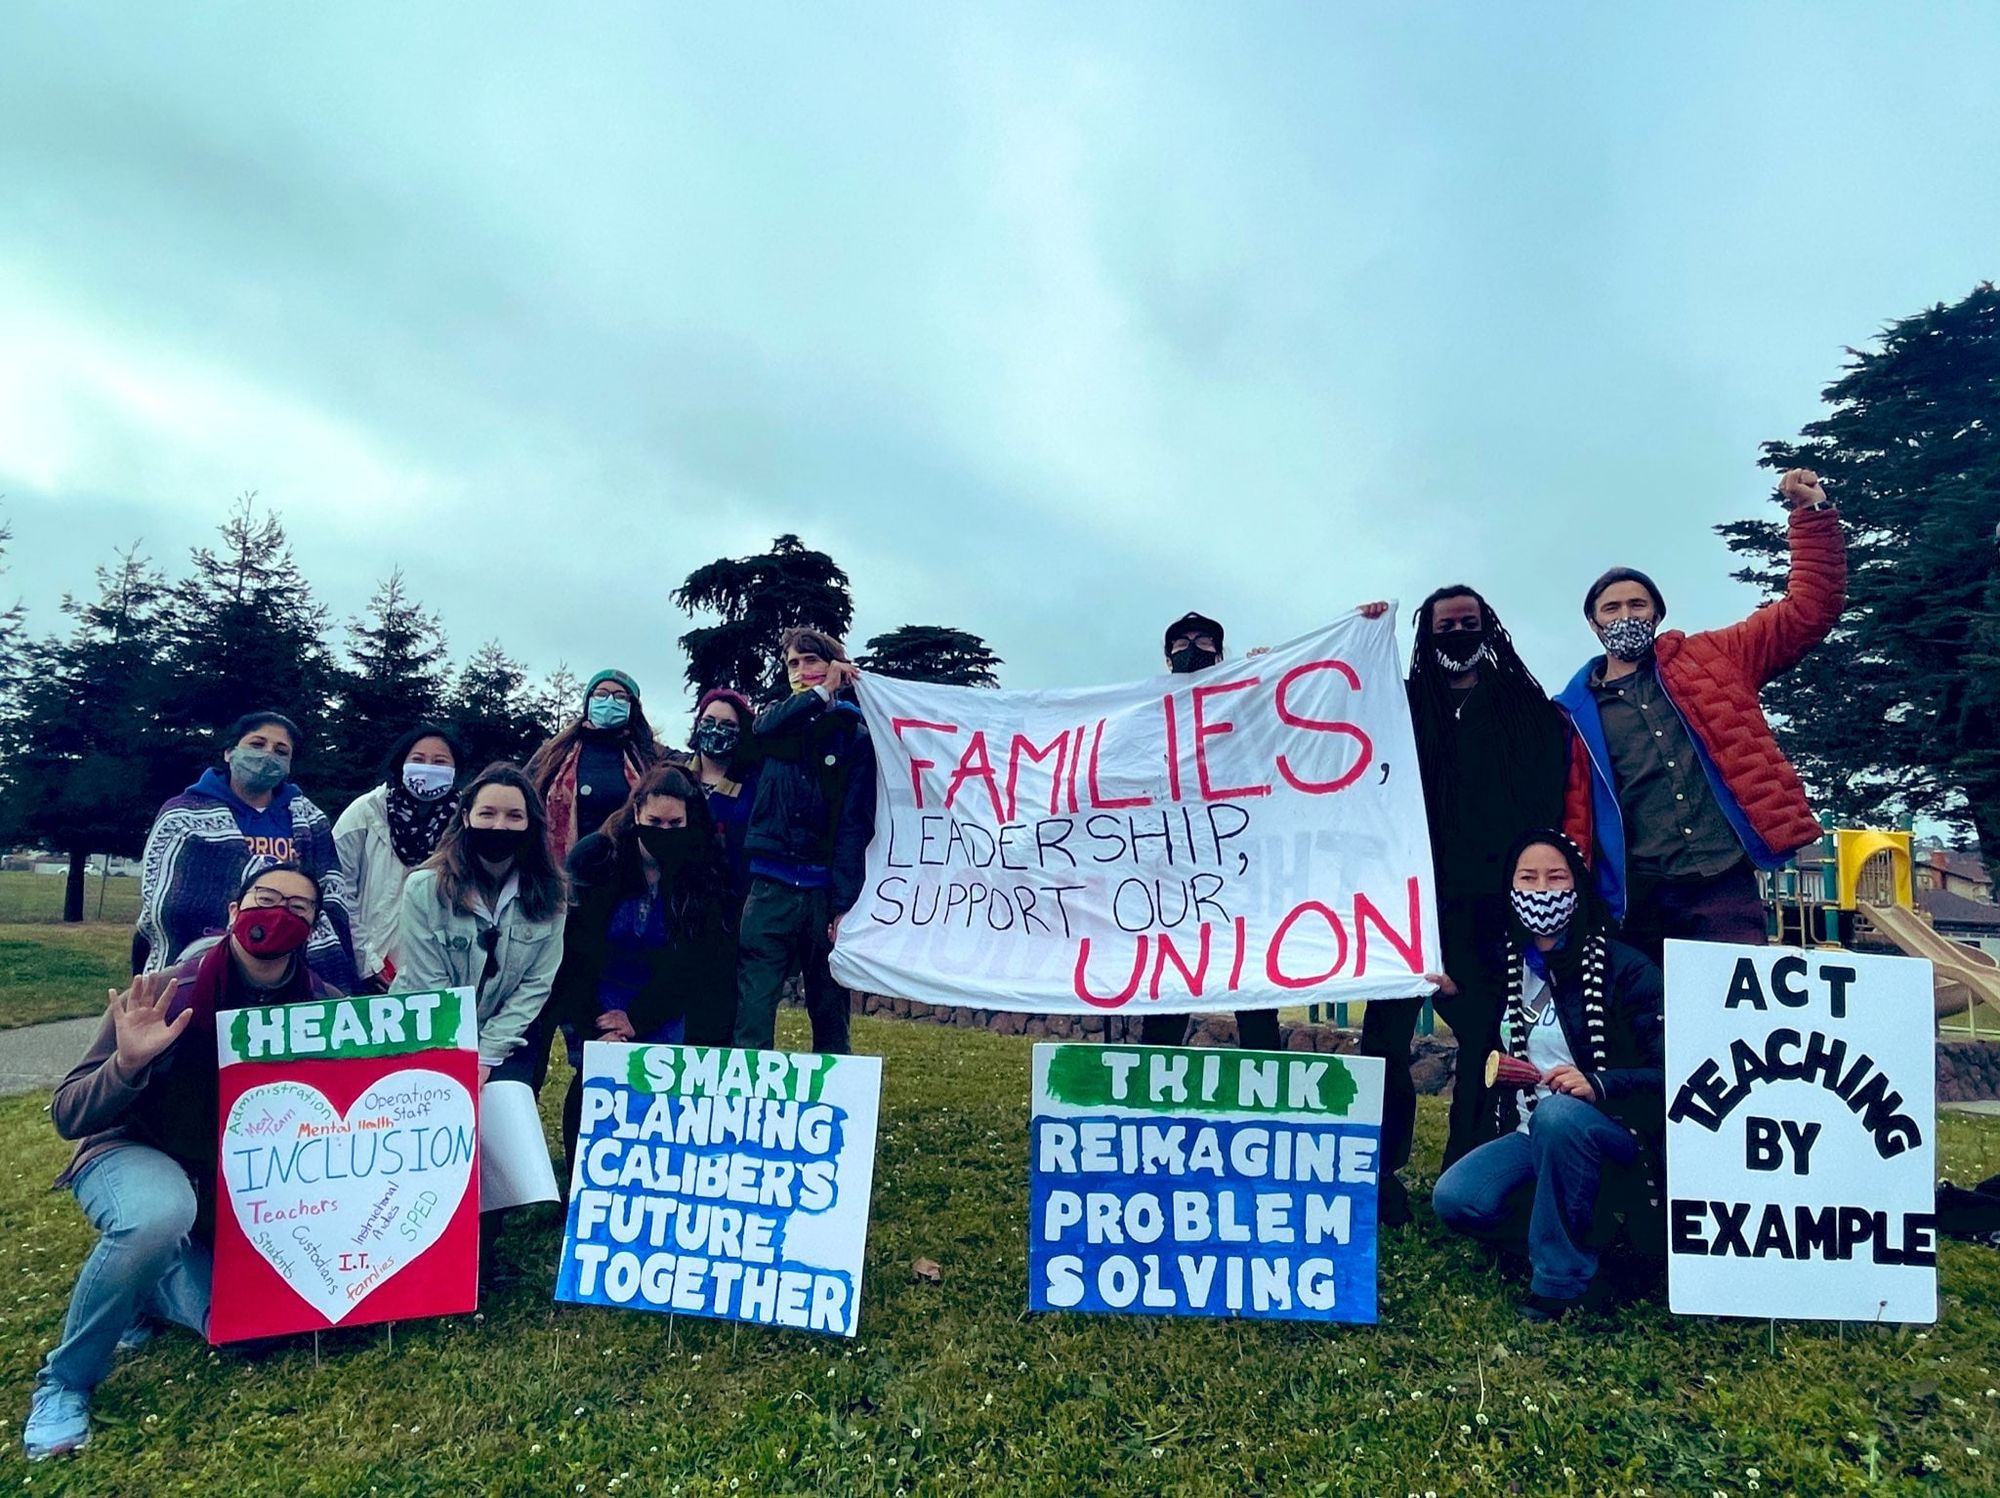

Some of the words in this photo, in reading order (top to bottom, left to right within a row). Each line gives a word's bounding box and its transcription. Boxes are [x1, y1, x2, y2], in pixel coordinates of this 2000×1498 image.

[892, 659, 1390, 825] FAMILIES,
[887, 803, 1249, 876] LEADERSHIP,
[871, 876, 1085, 938] SUPPORT
[1113, 873, 1231, 932] OUR
[1073, 876, 1425, 1008] UNION
[1724, 955, 1856, 1018] ACT
[247, 994, 440, 1057] HEART
[365, 1082, 451, 1110] Operations
[643, 1046, 822, 1102] SMART
[1101, 1052, 1328, 1109] THINK
[1668, 1027, 1922, 1160] TEACHING
[229, 1083, 331, 1135] Administration
[298, 1121, 351, 1138] Mental
[358, 1116, 394, 1130] Health
[393, 1103, 431, 1121] Staff
[580, 1087, 833, 1154] PLANNING
[233, 1124, 475, 1193] INCLUSION
[1040, 1123, 1378, 1185] REIMAGINE
[1745, 1116, 1821, 1175] BY
[247, 1199, 338, 1225] Teachers
[400, 1191, 438, 1242] SPED
[576, 1190, 777, 1263] FUTURE
[1044, 1190, 1351, 1244] PROBLEM
[1671, 1199, 1936, 1267] EXAMPLE
[292, 1226, 338, 1295] Custodians
[338, 1253, 370, 1271] I.T.
[574, 1244, 847, 1333] TOGETHER
[1046, 1254, 1335, 1311] SOLVING
